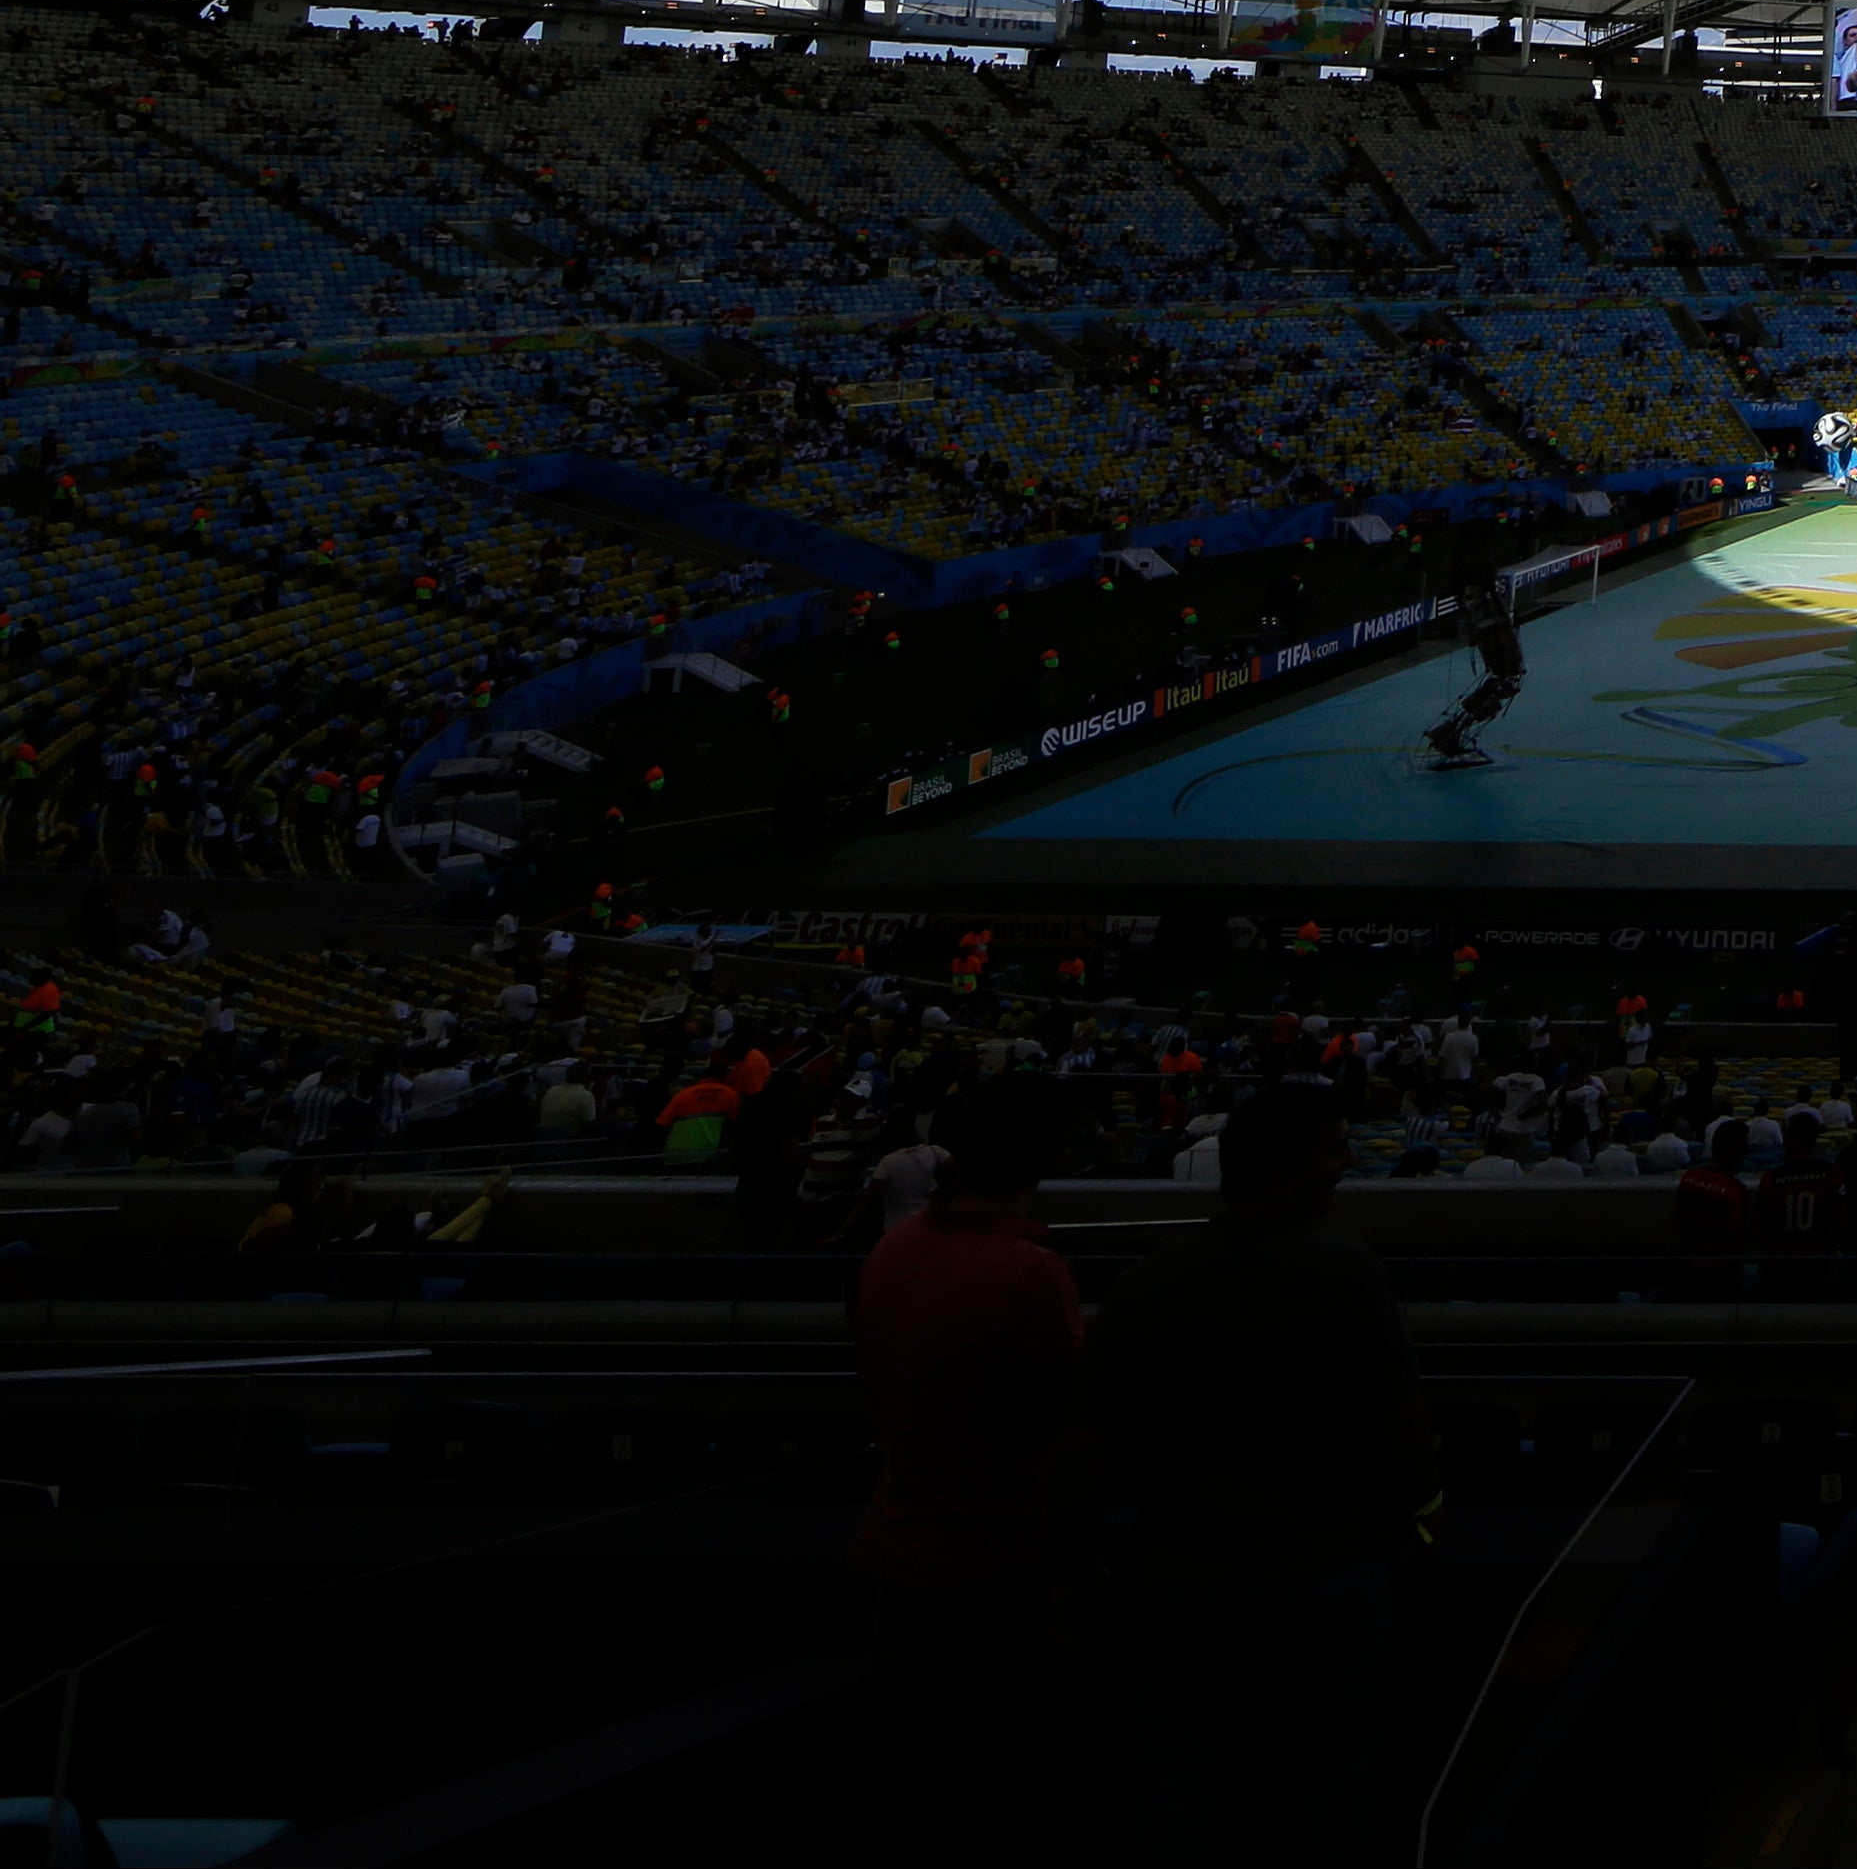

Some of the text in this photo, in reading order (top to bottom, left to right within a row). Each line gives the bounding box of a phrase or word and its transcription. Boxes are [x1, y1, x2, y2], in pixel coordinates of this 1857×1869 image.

[1772, 402, 1798, 412] Final
[1215, 660, 1250, 694] Itaú
[1166, 677, 1201, 712] Itaú
[991, 755, 1029, 777] BEYOND
[992, 747, 1023, 765] BRASIL
[911, 782, 953, 806] BEYOND
[912, 774, 947, 795] BRASIL
[1485, 930, 1600, 947] POWERADE
[1783, 1190, 1815, 1233] 10
